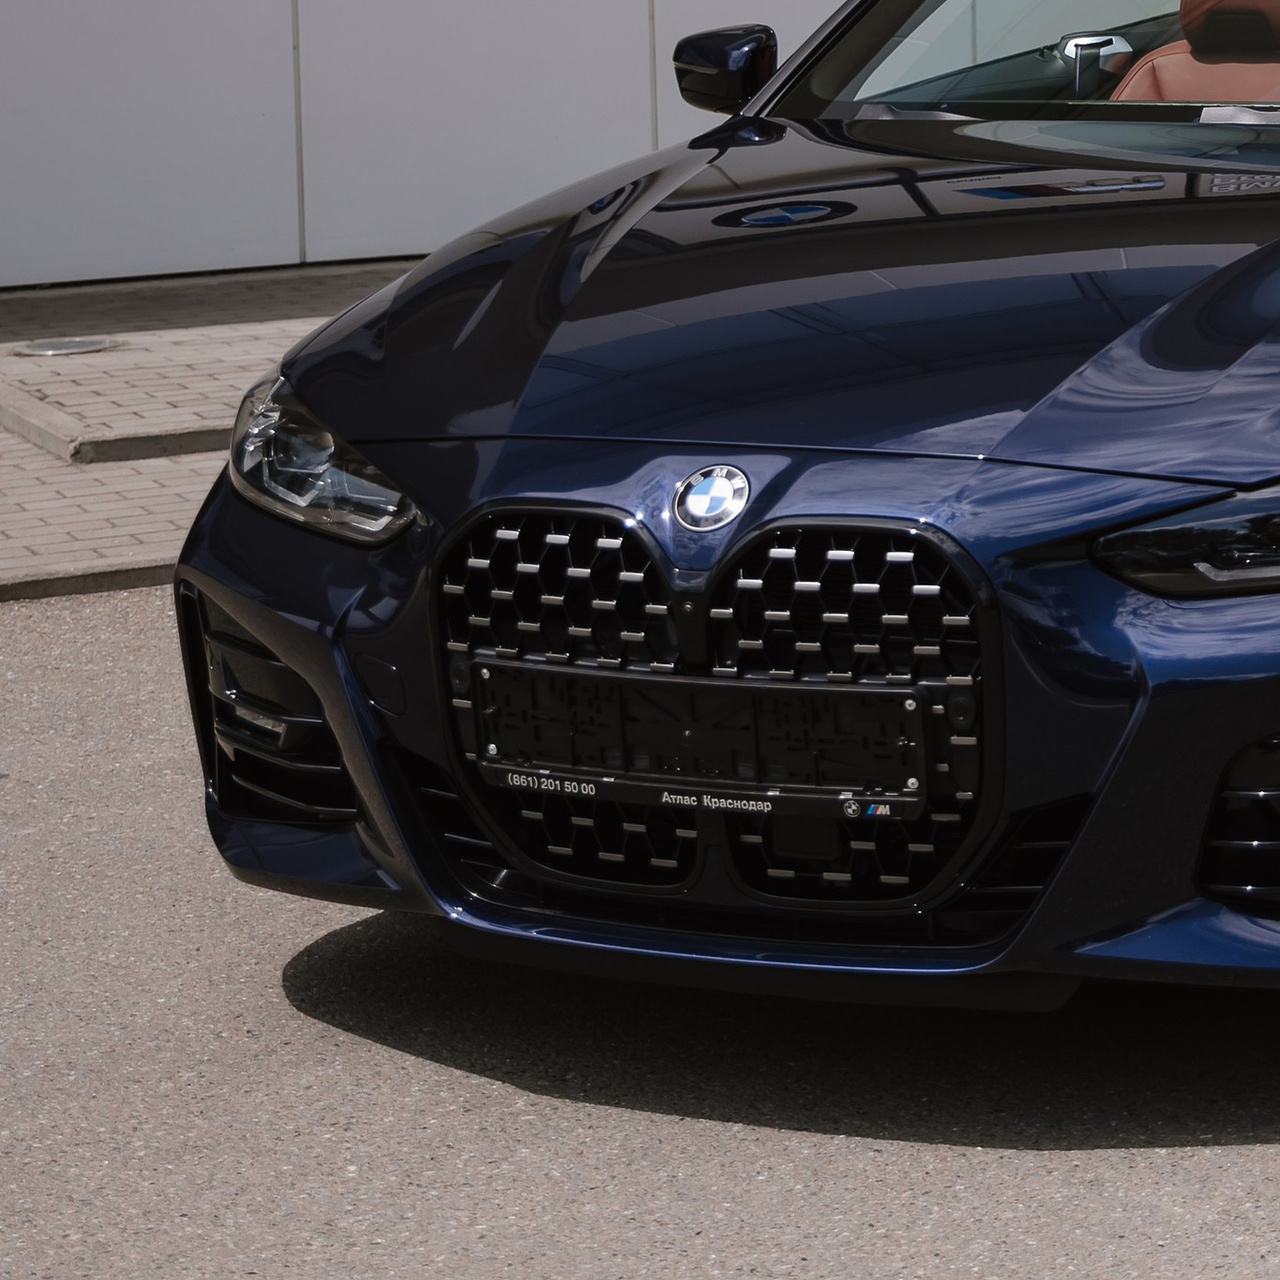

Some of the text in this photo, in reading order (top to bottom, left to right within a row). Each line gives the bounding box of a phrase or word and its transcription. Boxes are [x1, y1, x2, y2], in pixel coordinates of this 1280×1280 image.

[689, 468, 746, 489] BMW
[508, 772, 596, 795] (861) 201 50 00
[662, 791, 772, 813] Атлас Краснодар
